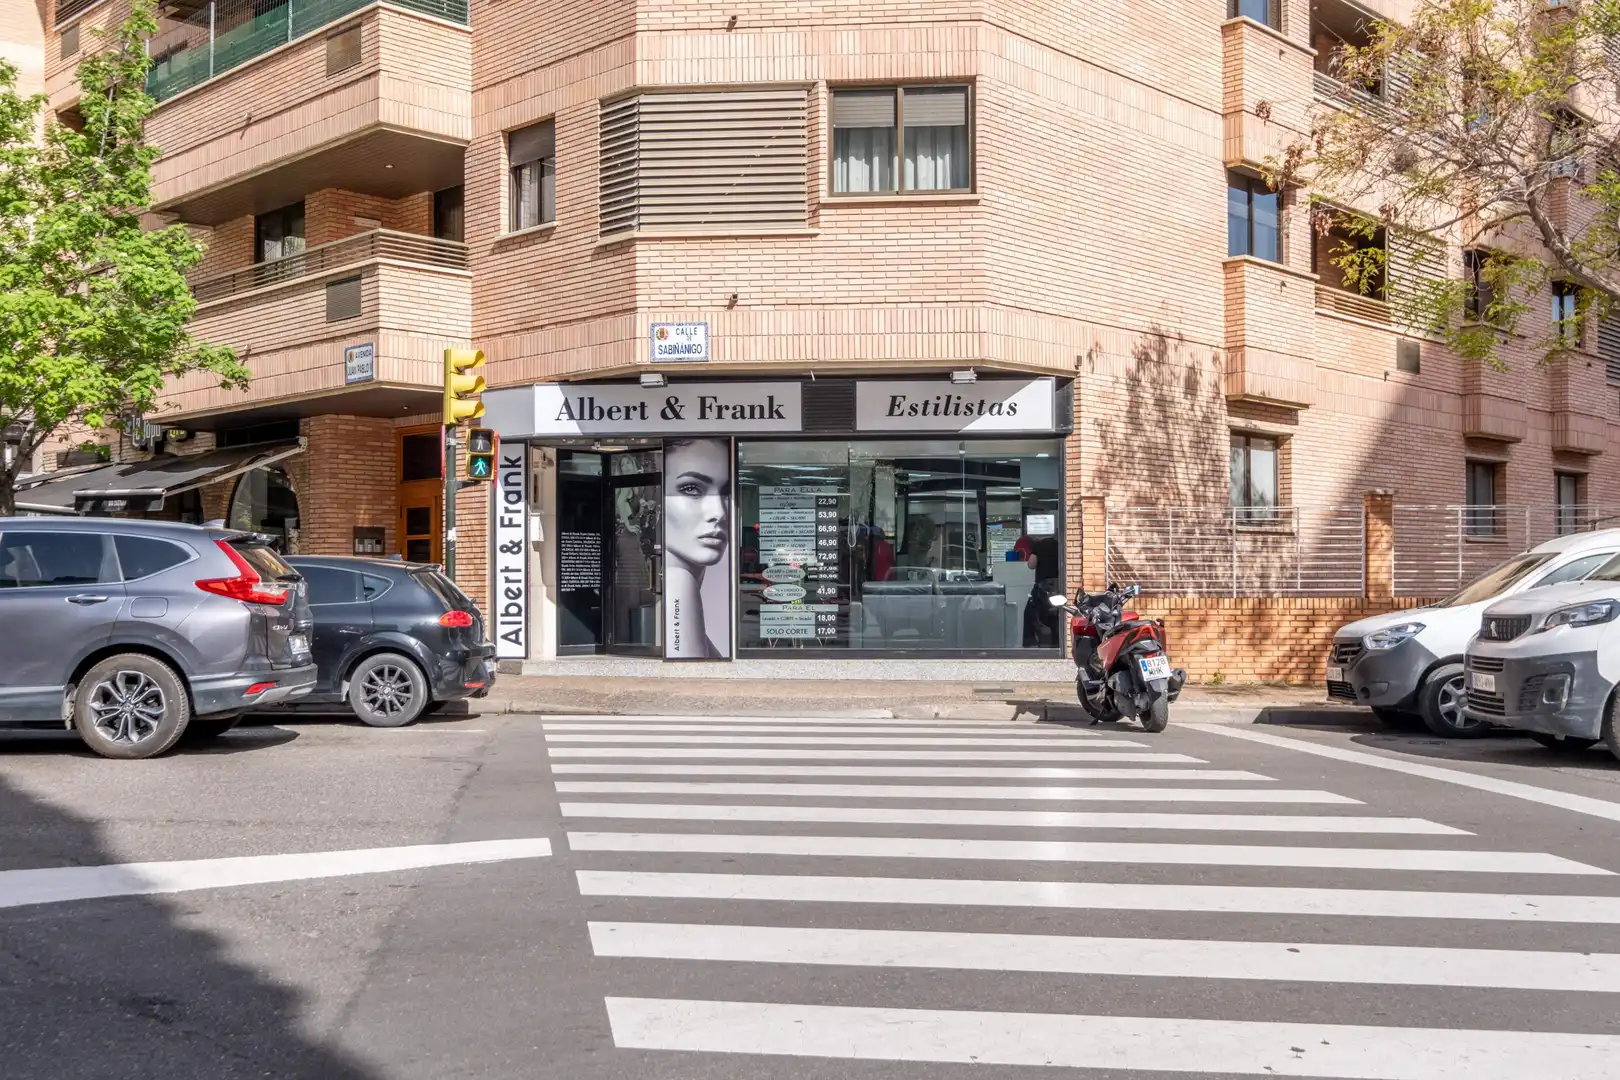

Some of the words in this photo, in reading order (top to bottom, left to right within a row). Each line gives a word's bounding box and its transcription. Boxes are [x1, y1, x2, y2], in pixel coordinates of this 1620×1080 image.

[676, 327, 698, 335] CALLE
[555, 396, 648, 421] Albert
[660, 395, 686, 420] &
[697, 395, 786, 420] Frank
[886, 395, 1018, 417] Estilistas
[500, 456, 522, 528] Frank
[499, 539, 522, 555] &
[500, 566, 522, 646] Albert
